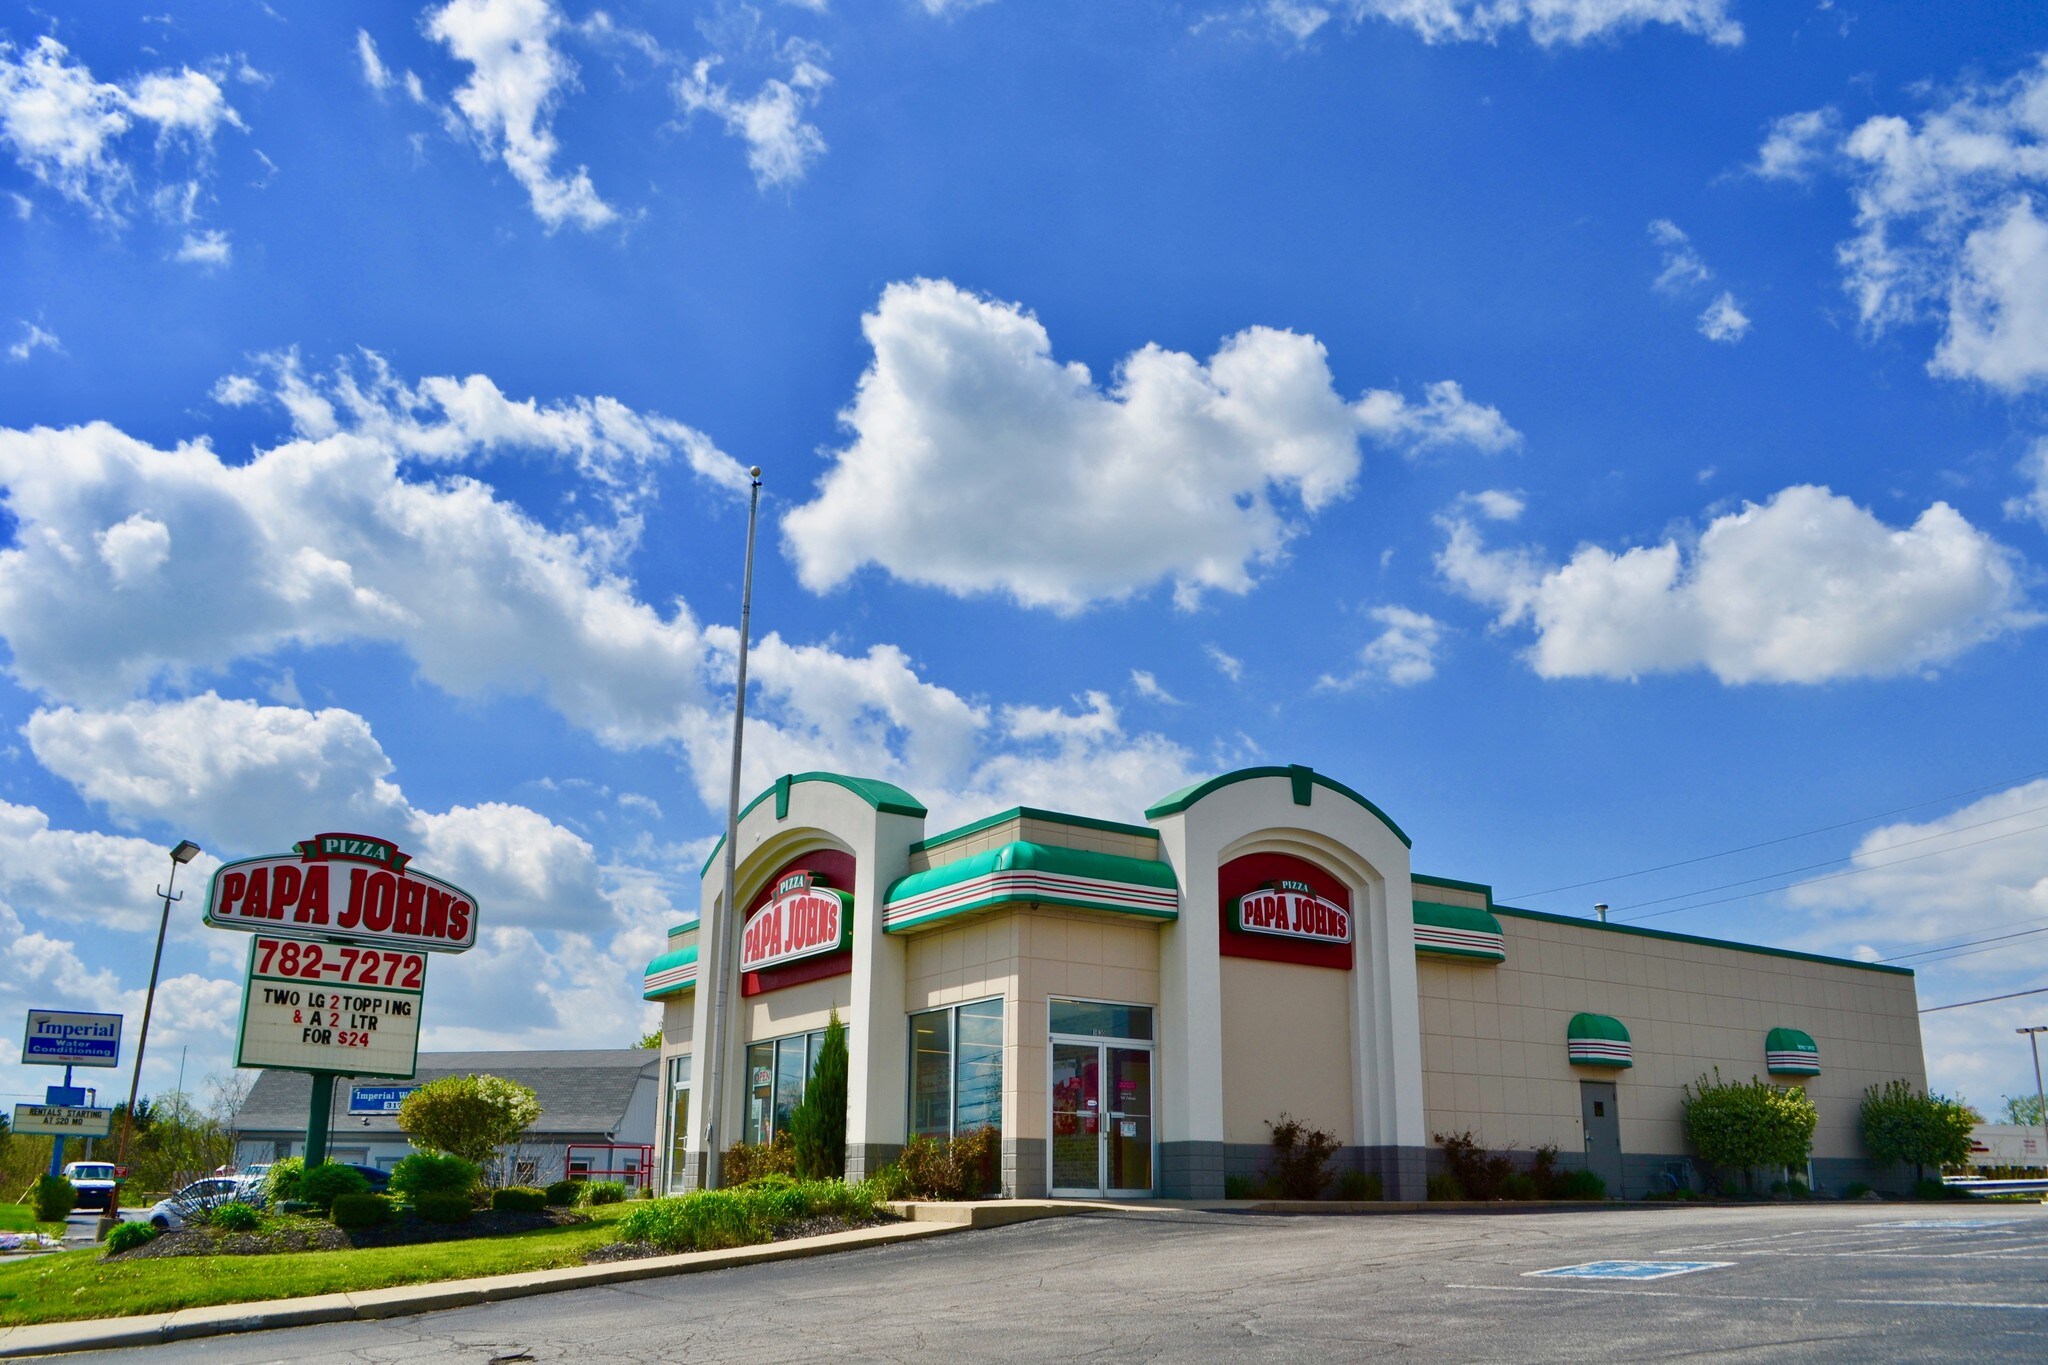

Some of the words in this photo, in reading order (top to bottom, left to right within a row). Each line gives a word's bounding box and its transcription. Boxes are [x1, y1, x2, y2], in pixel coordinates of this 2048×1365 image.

[326, 839, 387, 860] PIZZA
[780, 876, 803, 894] PIZZA
[1282, 881, 1308, 892] PIZZA
[219, 866, 329, 924] PAPA
[338, 869, 470, 940] JOHN'S
[1244, 896, 1289, 930] PAPA
[1293, 898, 1346, 938] JOHN'S
[744, 906, 782, 963] PAPA
[785, 897, 838, 952] JOHN'S
[258, 940, 423, 988] 782-7272
[263, 988, 300, 1006] TWO
[308, 992, 325, 1009] LG
[329, 995, 340, 1010] 2
[343, 996, 412, 1015] TOPPING
[293, 1009, 303, 1024] &
[309, 1011, 322, 1026] A
[329, 1012, 340, 1028] 2
[350, 1014, 379, 1031] LTR
[37, 1021, 114, 1038] Imperial
[302, 1028, 332, 1045] FOR
[337, 1031, 370, 1047] $24
[33, 1045, 111, 1056] Conditioning
[56, 1039, 90, 1047] Water
[356, 1092, 395, 1101] Imperial
[30, 1108, 61, 1116] RENTALS
[67, 1110, 102, 1118] STARTING
[43, 1117, 53, 1125] AT
